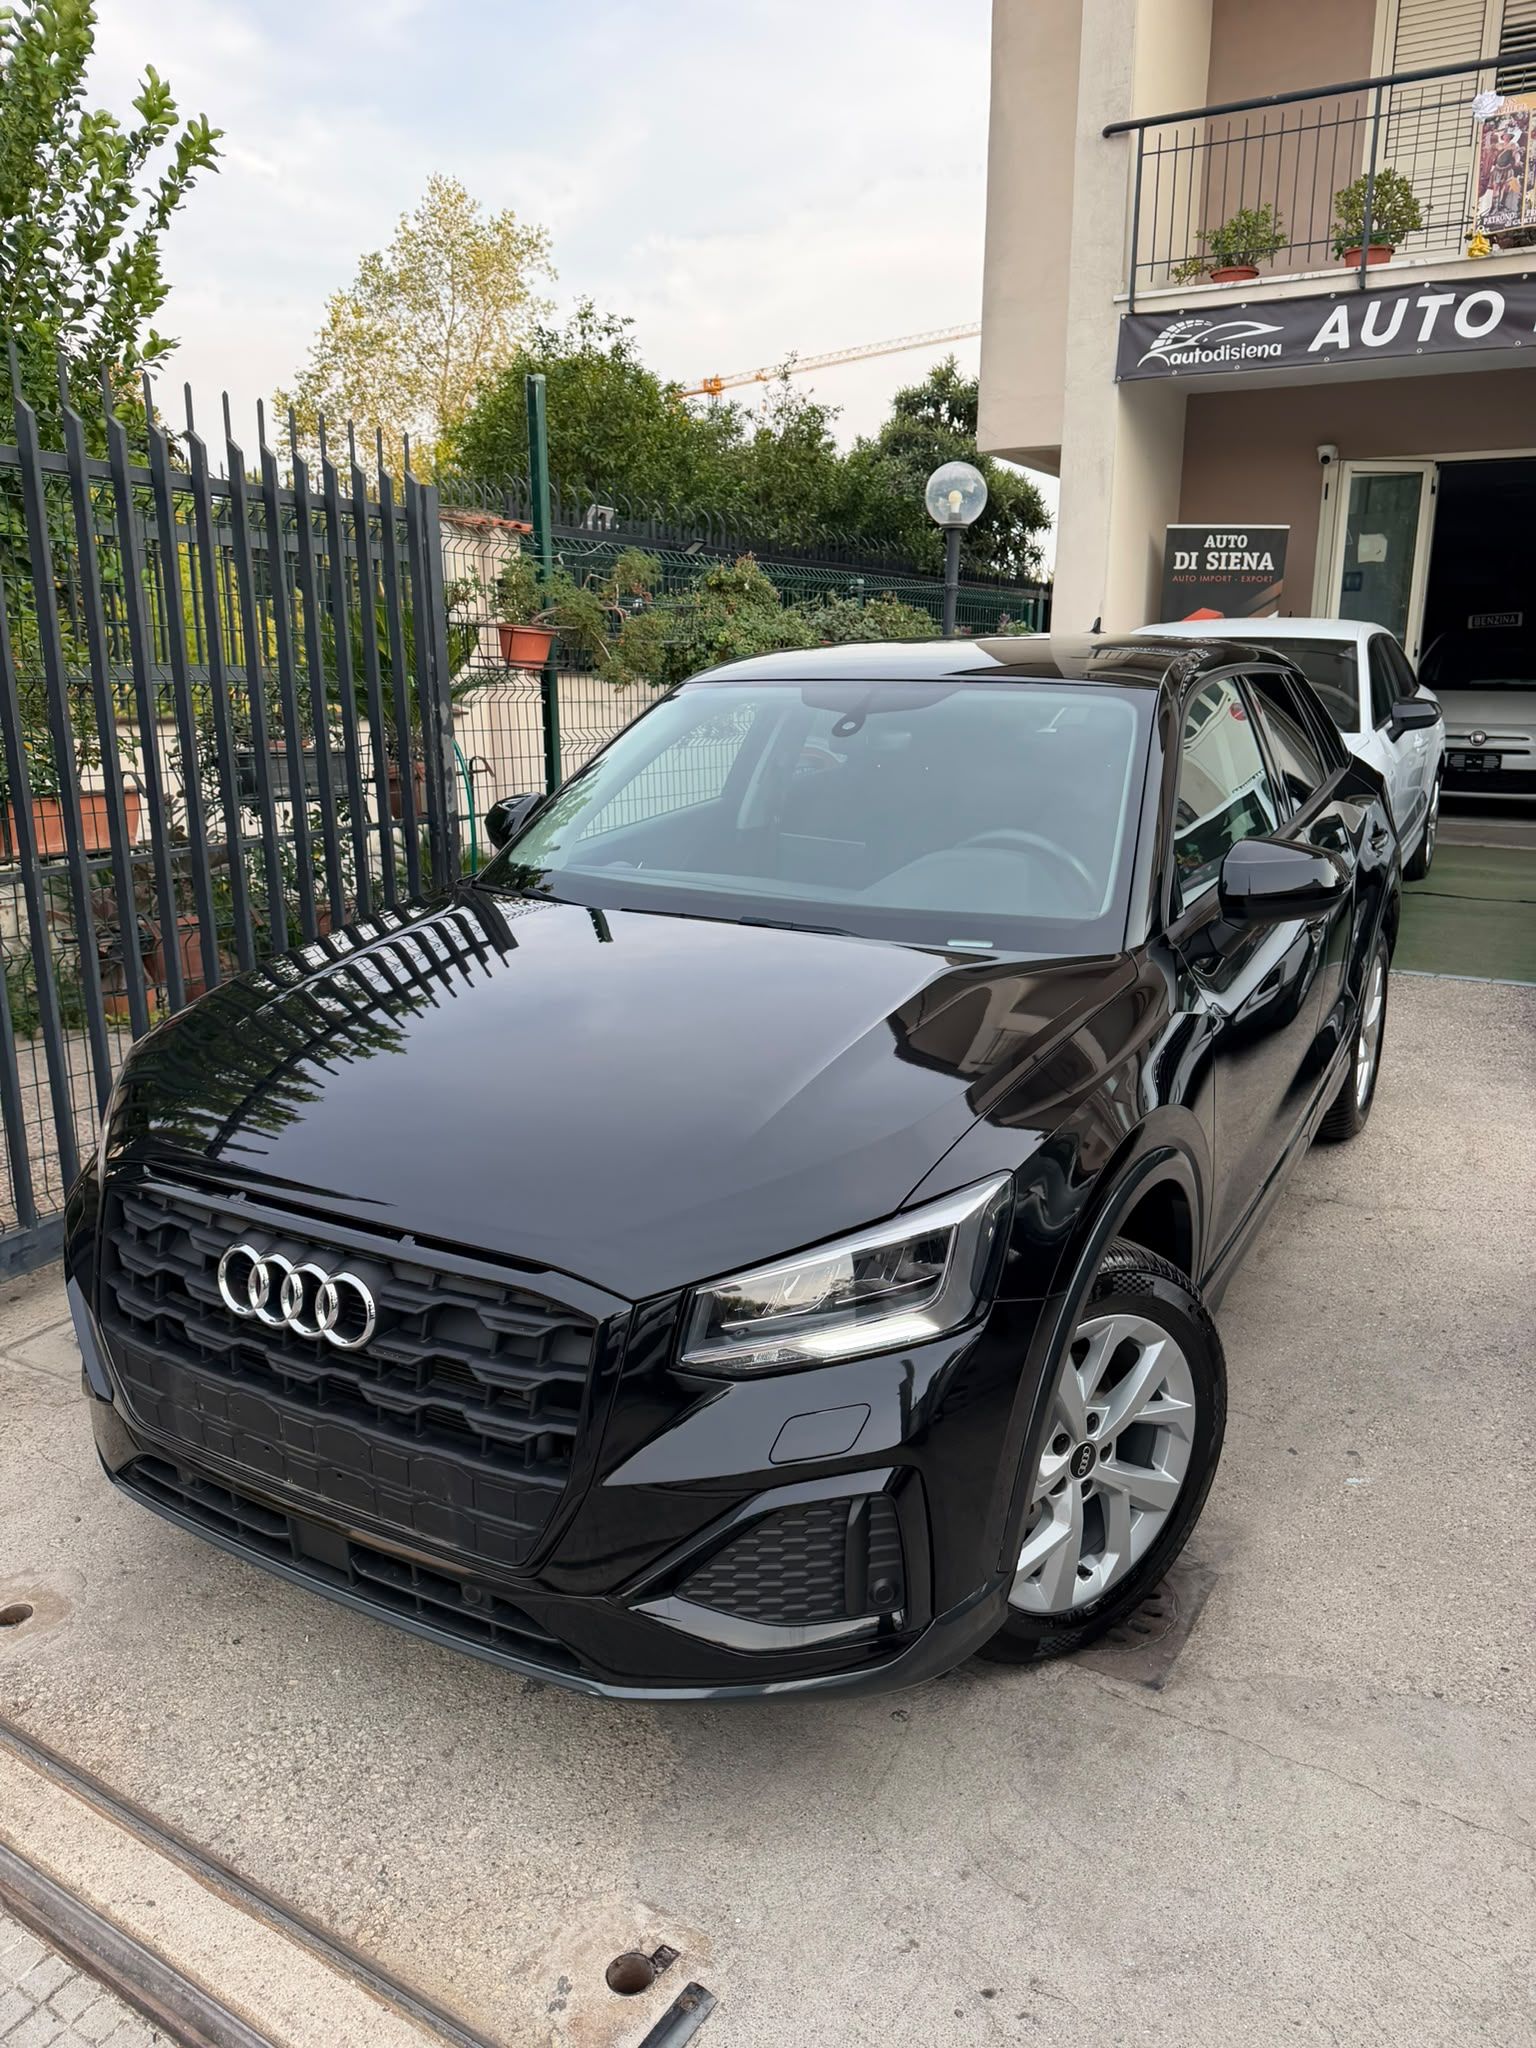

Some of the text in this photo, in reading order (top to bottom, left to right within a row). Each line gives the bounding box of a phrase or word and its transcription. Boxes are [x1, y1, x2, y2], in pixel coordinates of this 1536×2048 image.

[1307, 290, 1505, 352] AUTO
[1170, 342, 1282, 365] autodisiena
[1204, 535, 1248, 548] AUTO
[1173, 551, 1275, 570] DI SIENA
[1199, 575, 1232, 583] IMPORT
[1241, 575, 1273, 583] EXPORT
[1474, 615, 1515, 626] BENZINA
